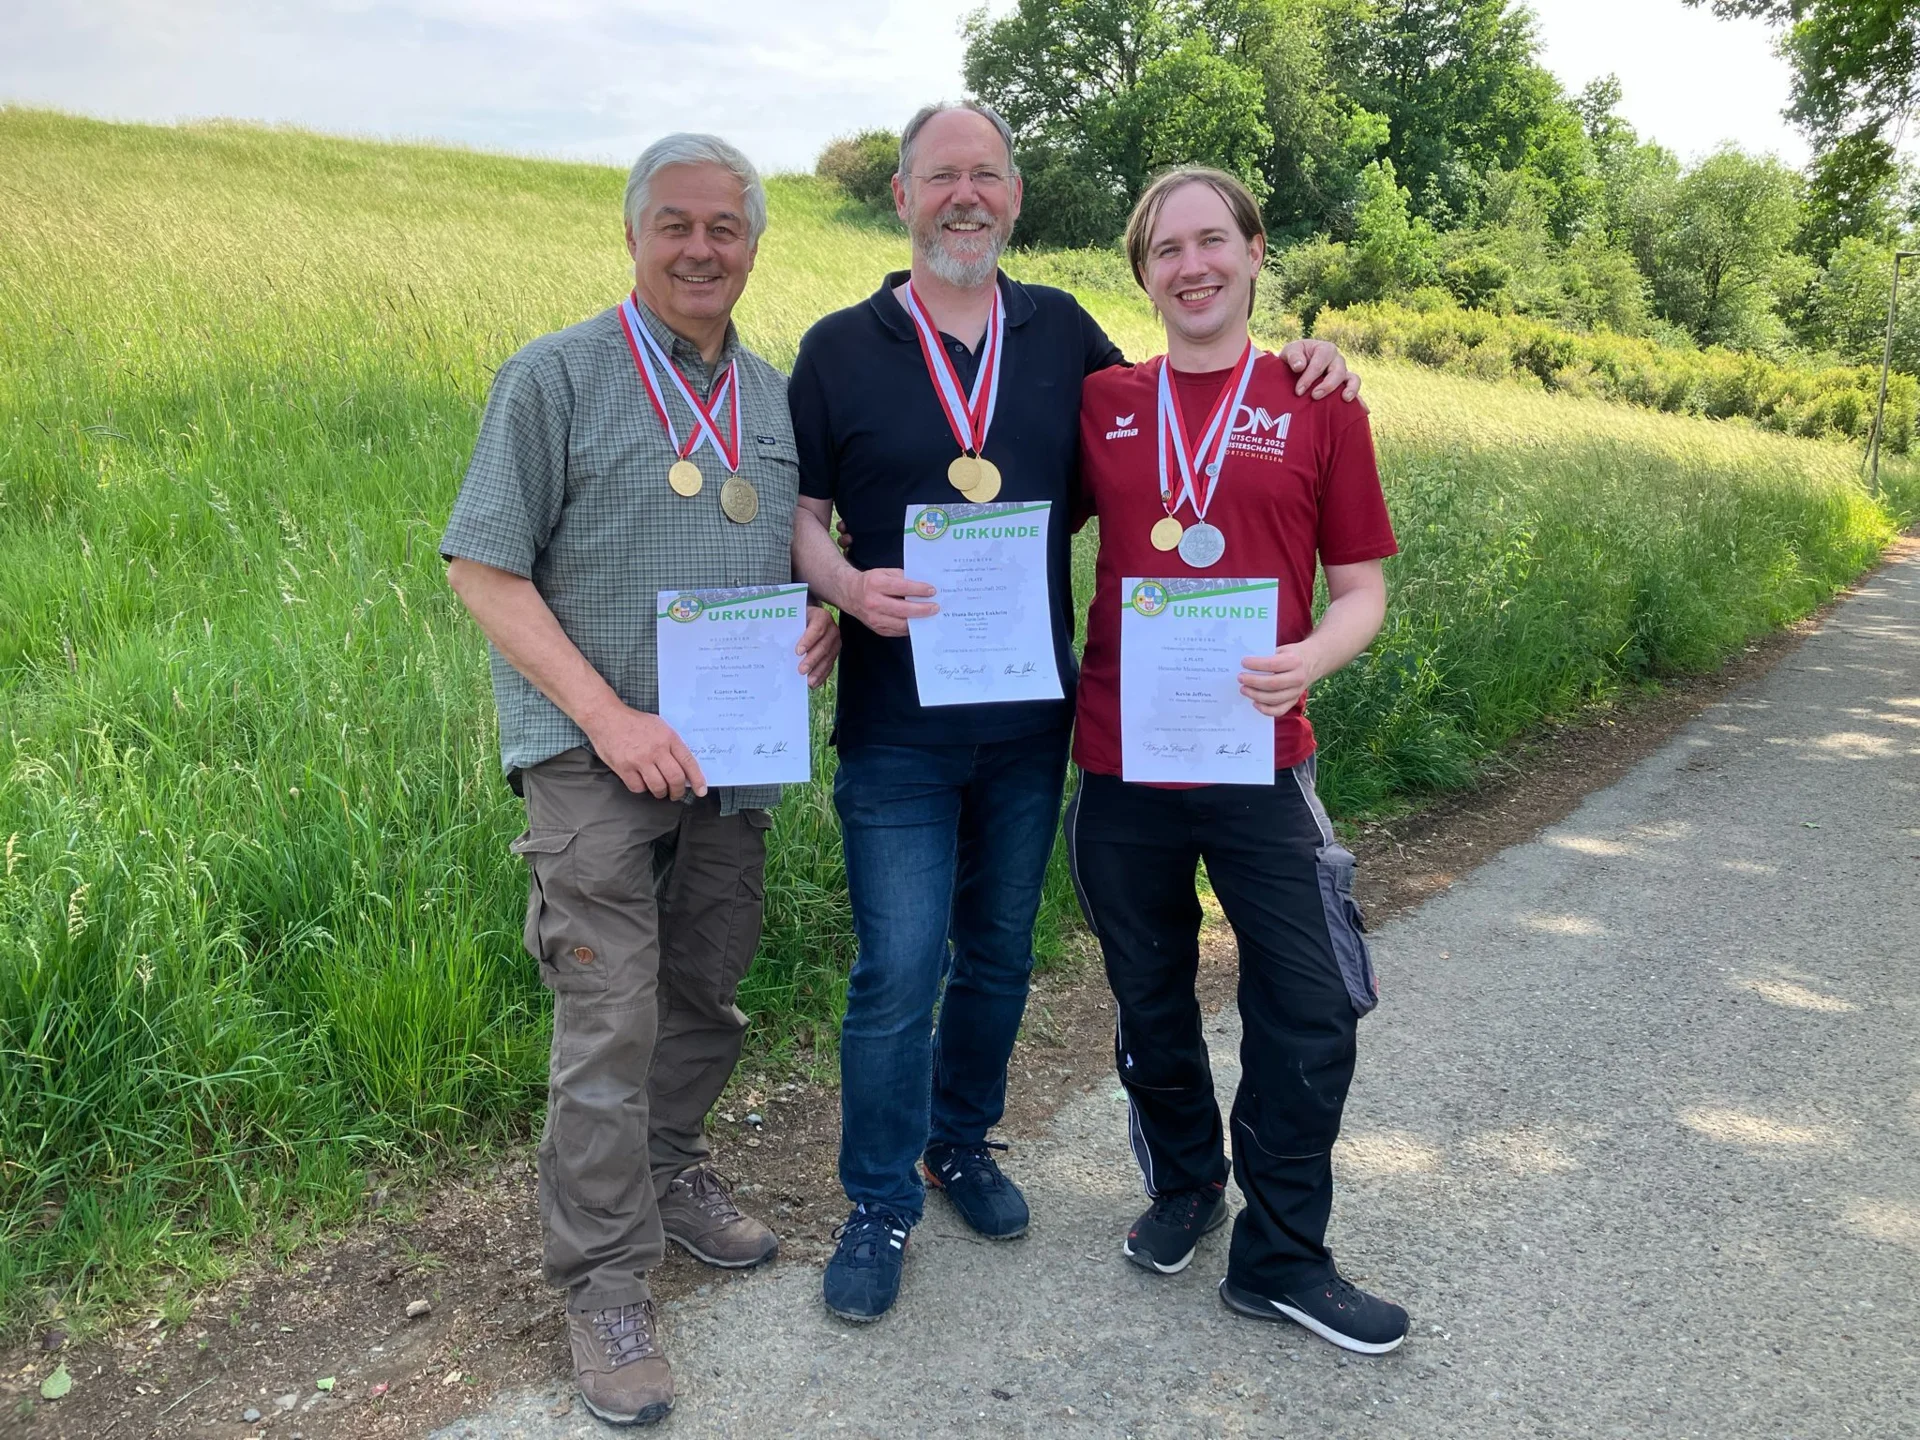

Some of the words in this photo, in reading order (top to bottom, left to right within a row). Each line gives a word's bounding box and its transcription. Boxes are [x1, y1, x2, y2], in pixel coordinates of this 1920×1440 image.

[1105, 428, 1138, 440] erima
[1226, 441, 1284, 456] ISTERSCHAFTEN
[1229, 434, 1263, 444] UTSCHE
[1264, 438, 1286, 449] 2025
[1224, 449, 1283, 463] ORTSCHIESSEN
[952, 526, 1040, 540] URKUNDE
[708, 606, 798, 621] URKUNDE
[1173, 605, 1269, 619] URKUNDE
